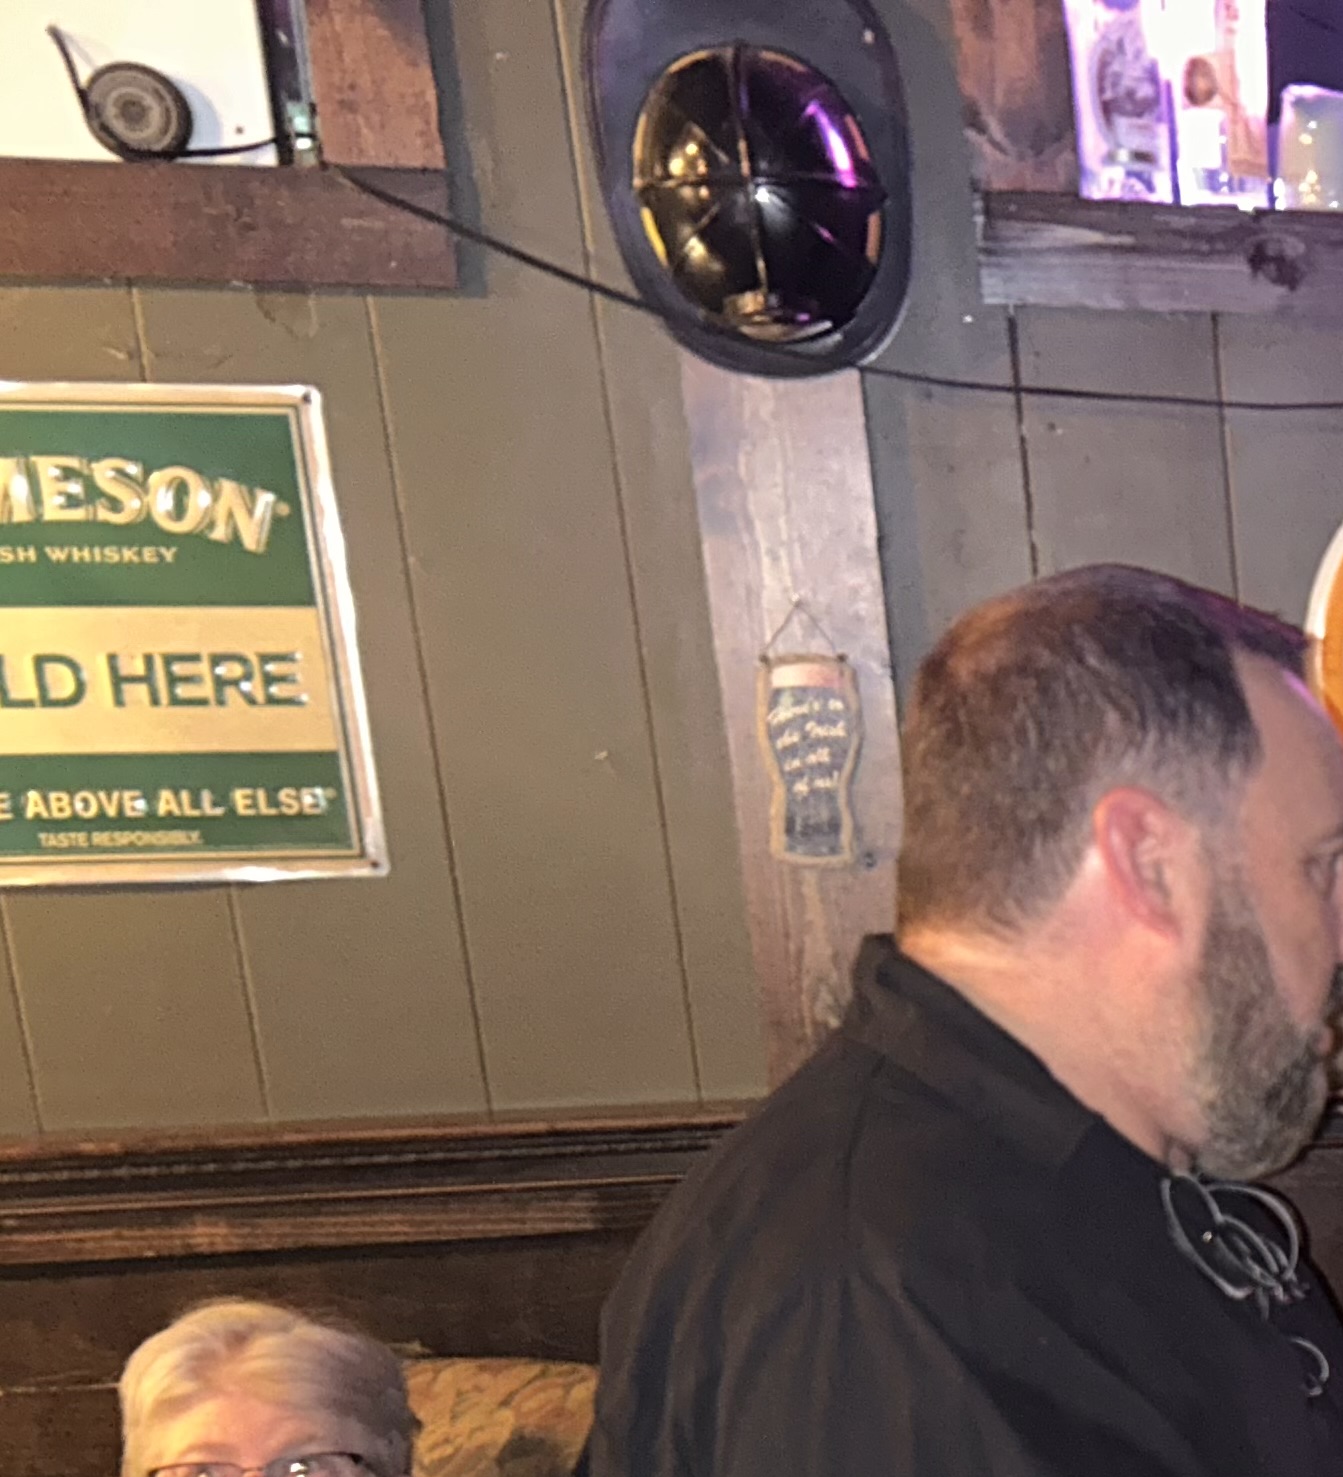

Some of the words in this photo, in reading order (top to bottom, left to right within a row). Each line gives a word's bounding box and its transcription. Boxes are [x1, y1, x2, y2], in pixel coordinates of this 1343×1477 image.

[46, 546, 177, 563] WHISKEY
[0, 653, 86, 708] LD
[106, 651, 308, 708] HERE
[25, 788, 146, 819] ABOVE
[157, 788, 225, 817] ALL
[235, 786, 328, 816] ELSE
